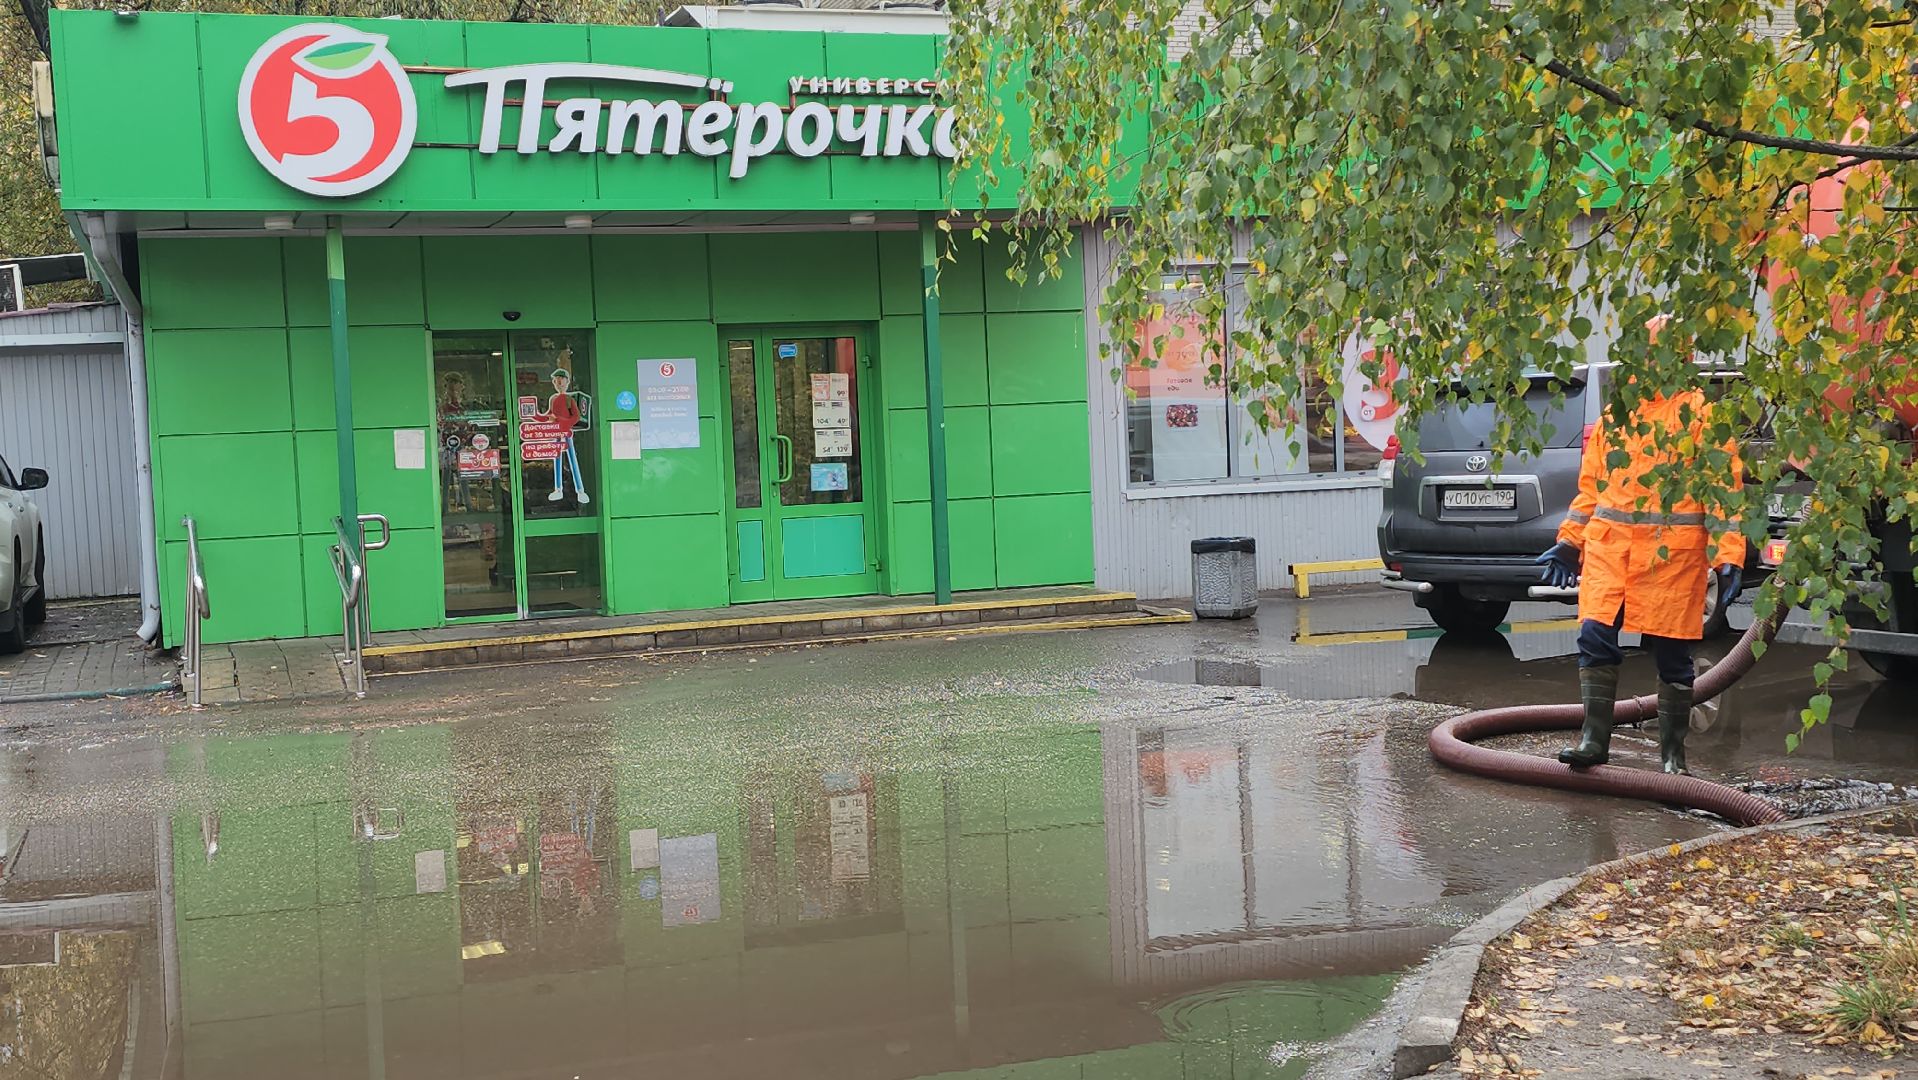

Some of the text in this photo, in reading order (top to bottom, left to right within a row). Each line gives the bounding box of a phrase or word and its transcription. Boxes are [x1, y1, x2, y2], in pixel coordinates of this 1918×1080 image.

[788, 74, 955, 95] УНИВЕРС
[524, 423, 560, 432] Доставка
[536, 442, 566, 451] работу
[532, 450, 558, 458] домой
